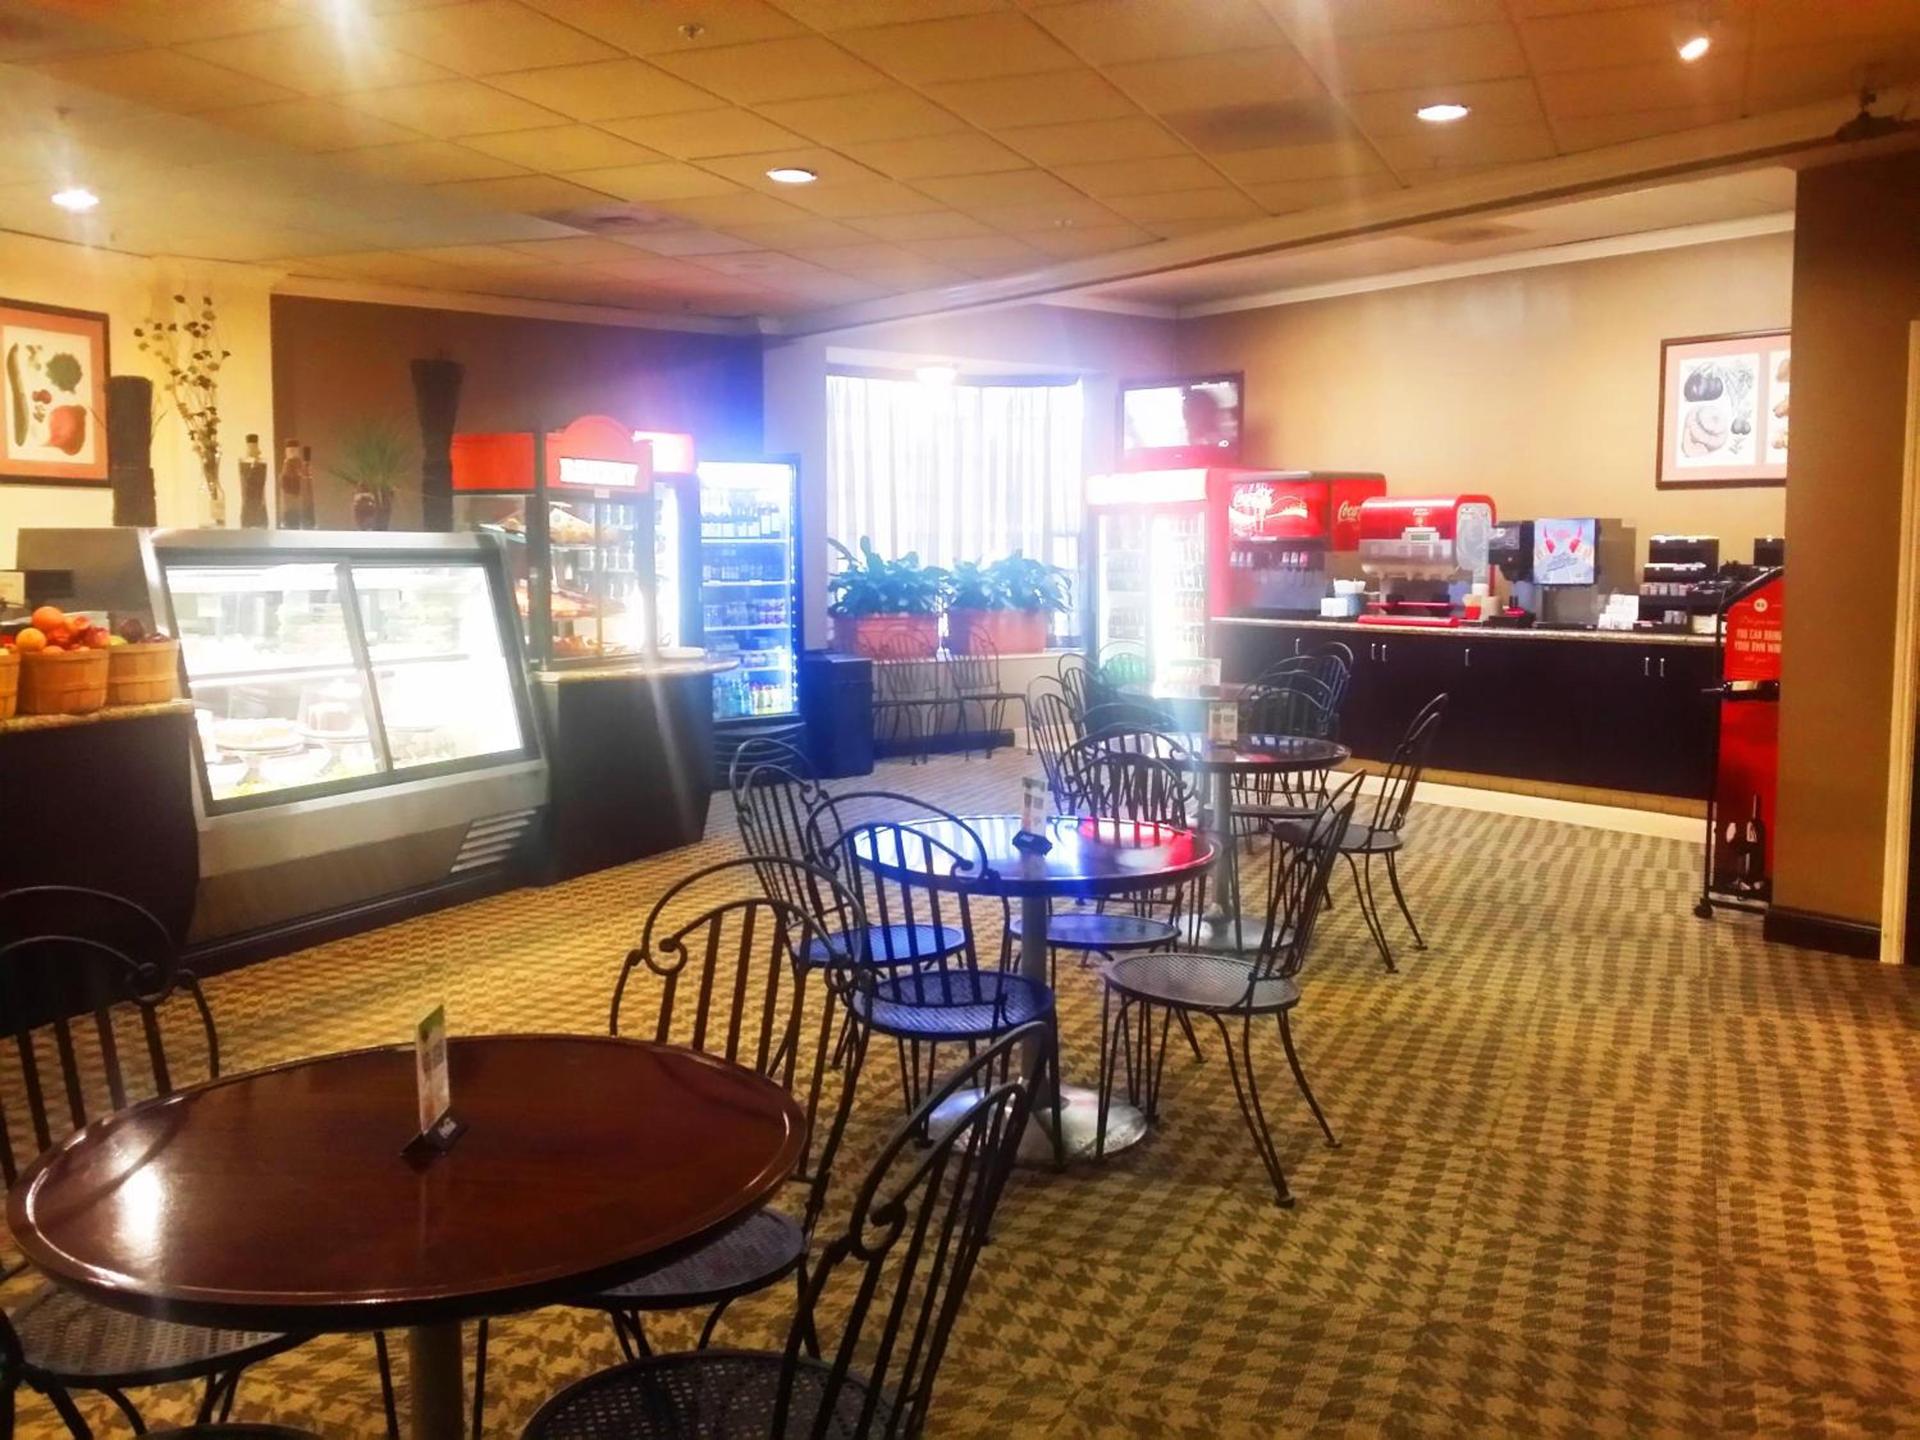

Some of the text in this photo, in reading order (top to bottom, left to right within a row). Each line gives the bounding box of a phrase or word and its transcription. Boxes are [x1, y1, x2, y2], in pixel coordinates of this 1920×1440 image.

[1749, 629, 1762, 640] CAN
[1734, 640, 1750, 651] YOUR
[1751, 642, 1766, 653] OWN
